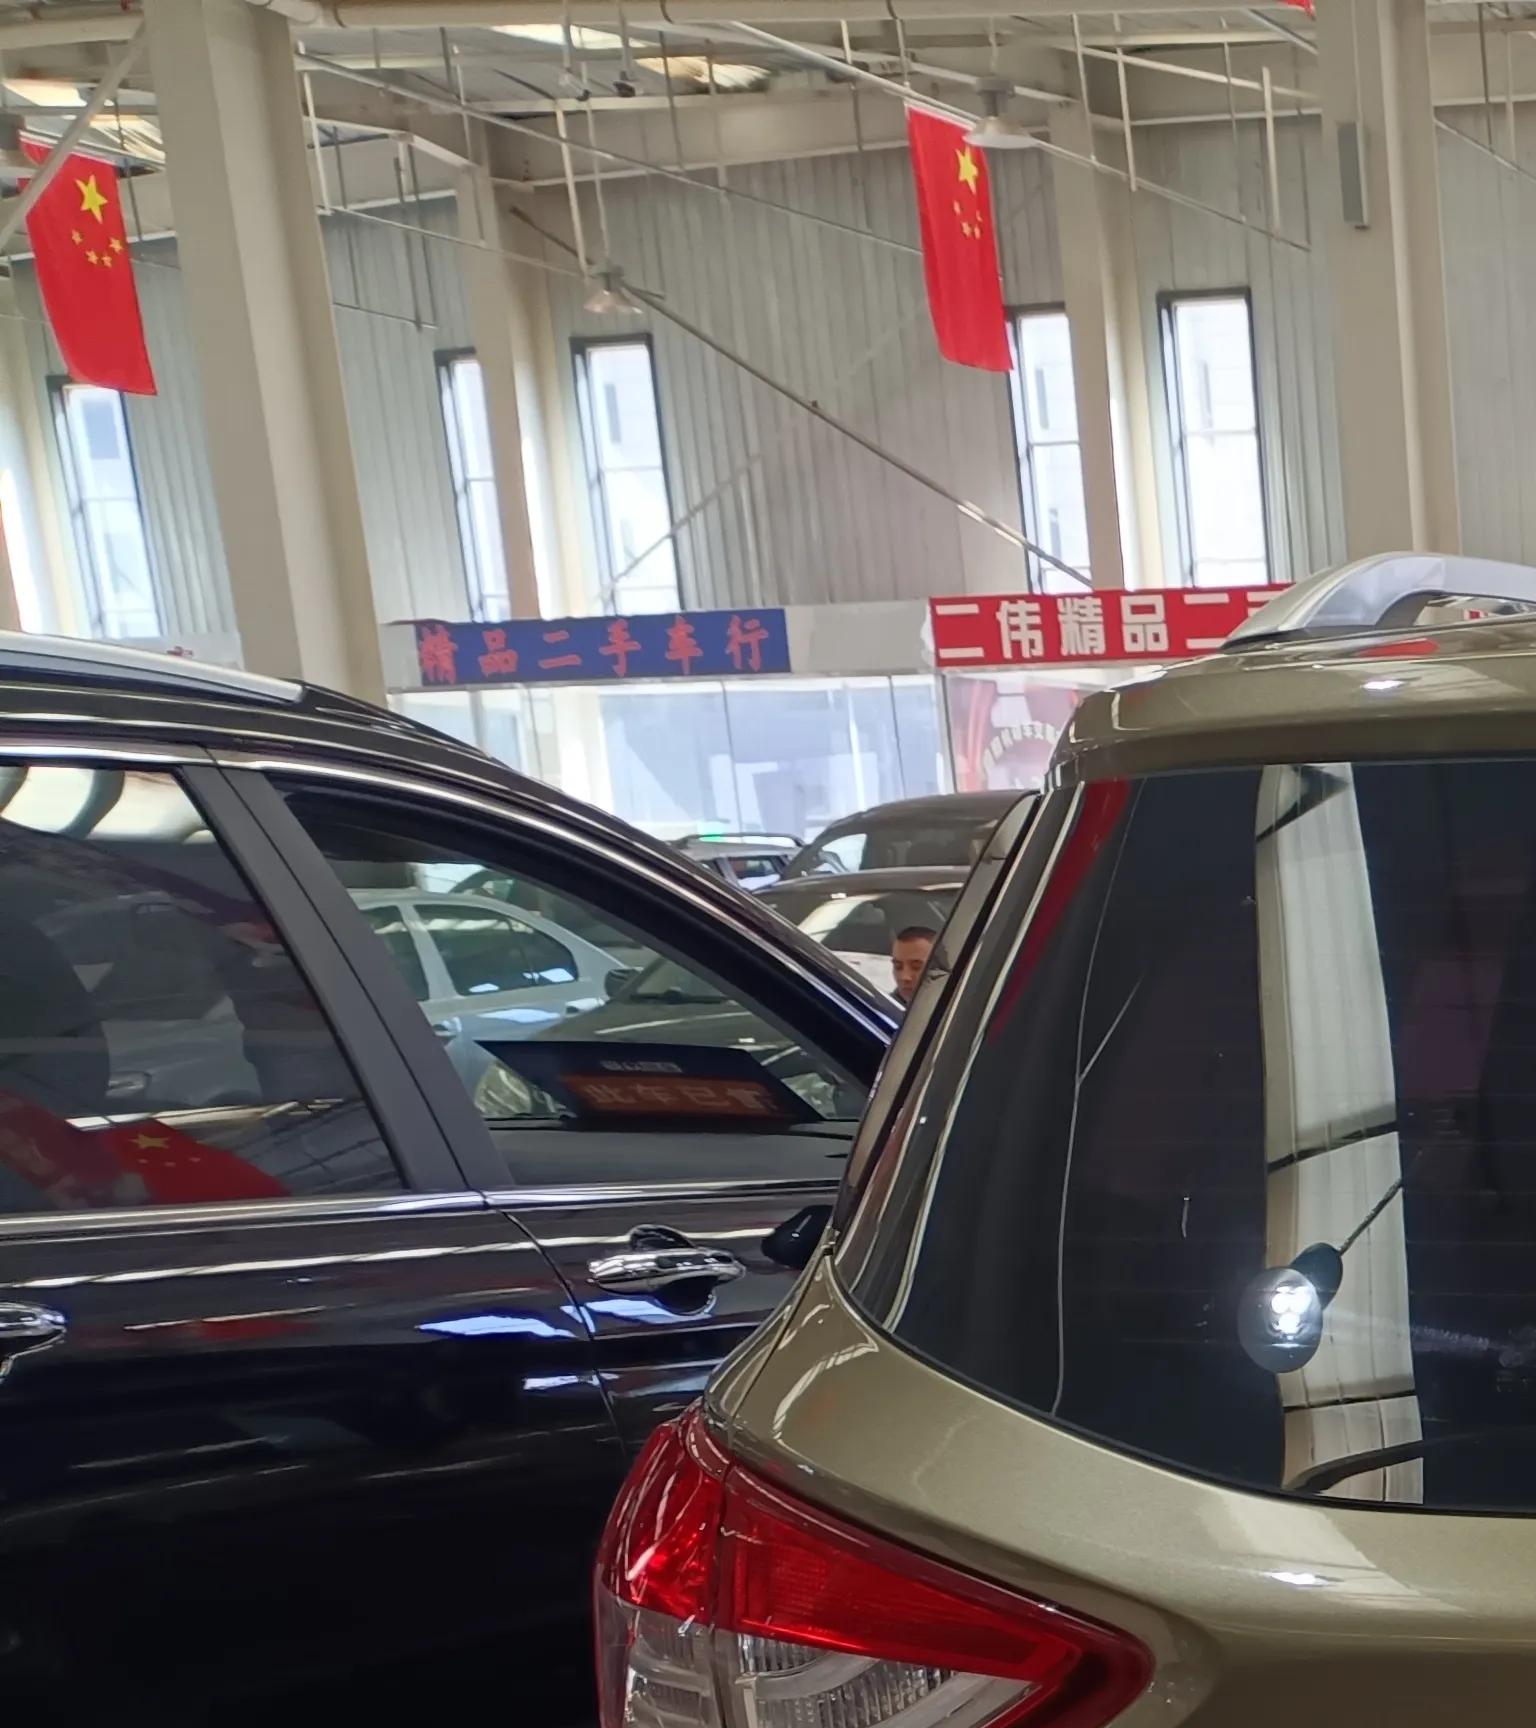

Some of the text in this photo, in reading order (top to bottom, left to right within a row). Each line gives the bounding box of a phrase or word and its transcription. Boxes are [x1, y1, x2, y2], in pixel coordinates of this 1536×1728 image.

[418, 614, 770, 685] 精品二手车行
